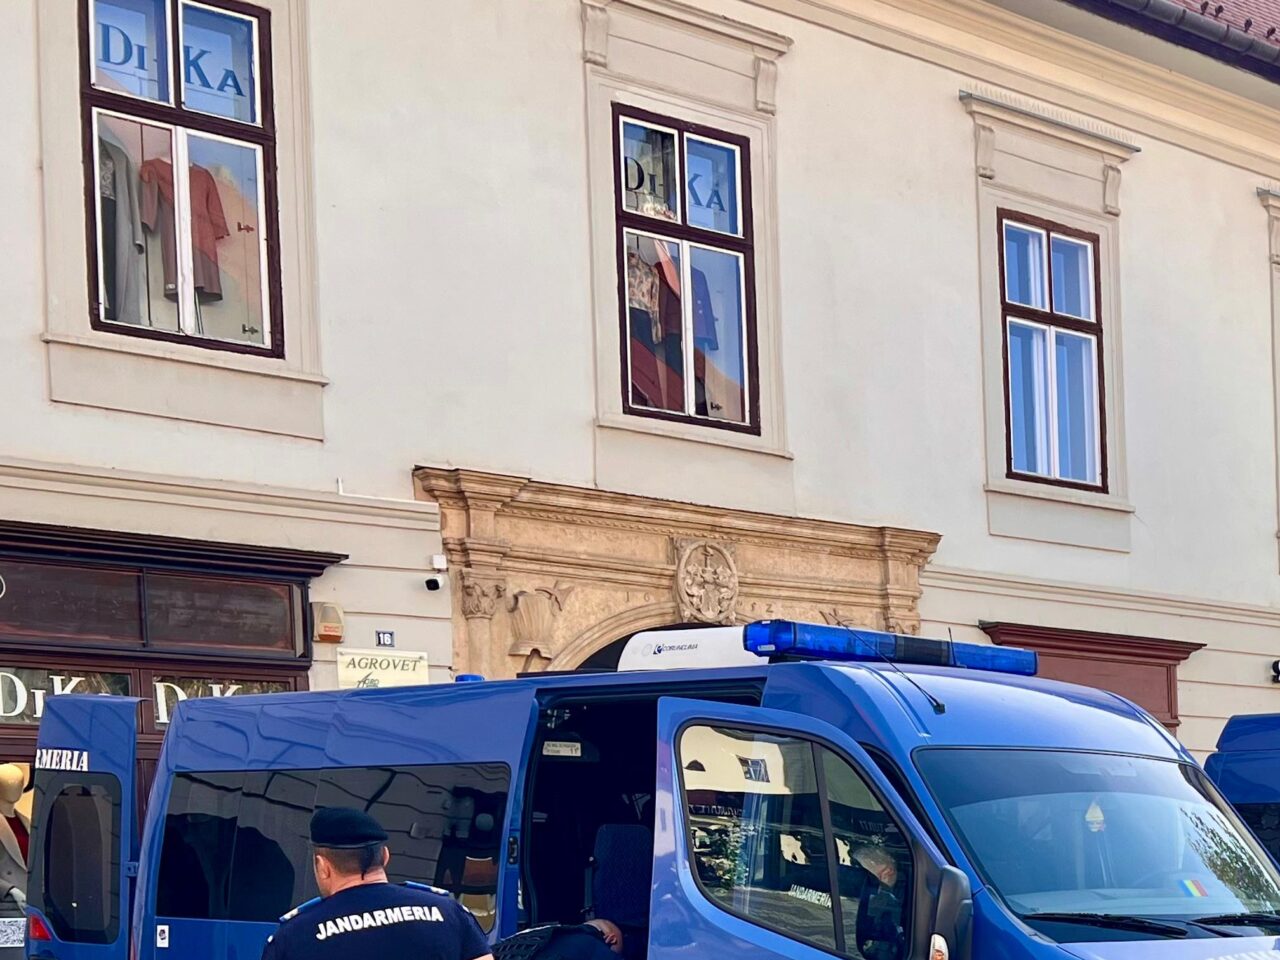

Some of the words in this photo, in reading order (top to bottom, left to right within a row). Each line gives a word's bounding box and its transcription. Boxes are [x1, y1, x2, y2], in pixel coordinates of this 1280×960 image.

[378, 632, 393, 645] 16
[346, 657, 421, 672] AGROVET
[316, 906, 444, 940] JANDARMERIA
